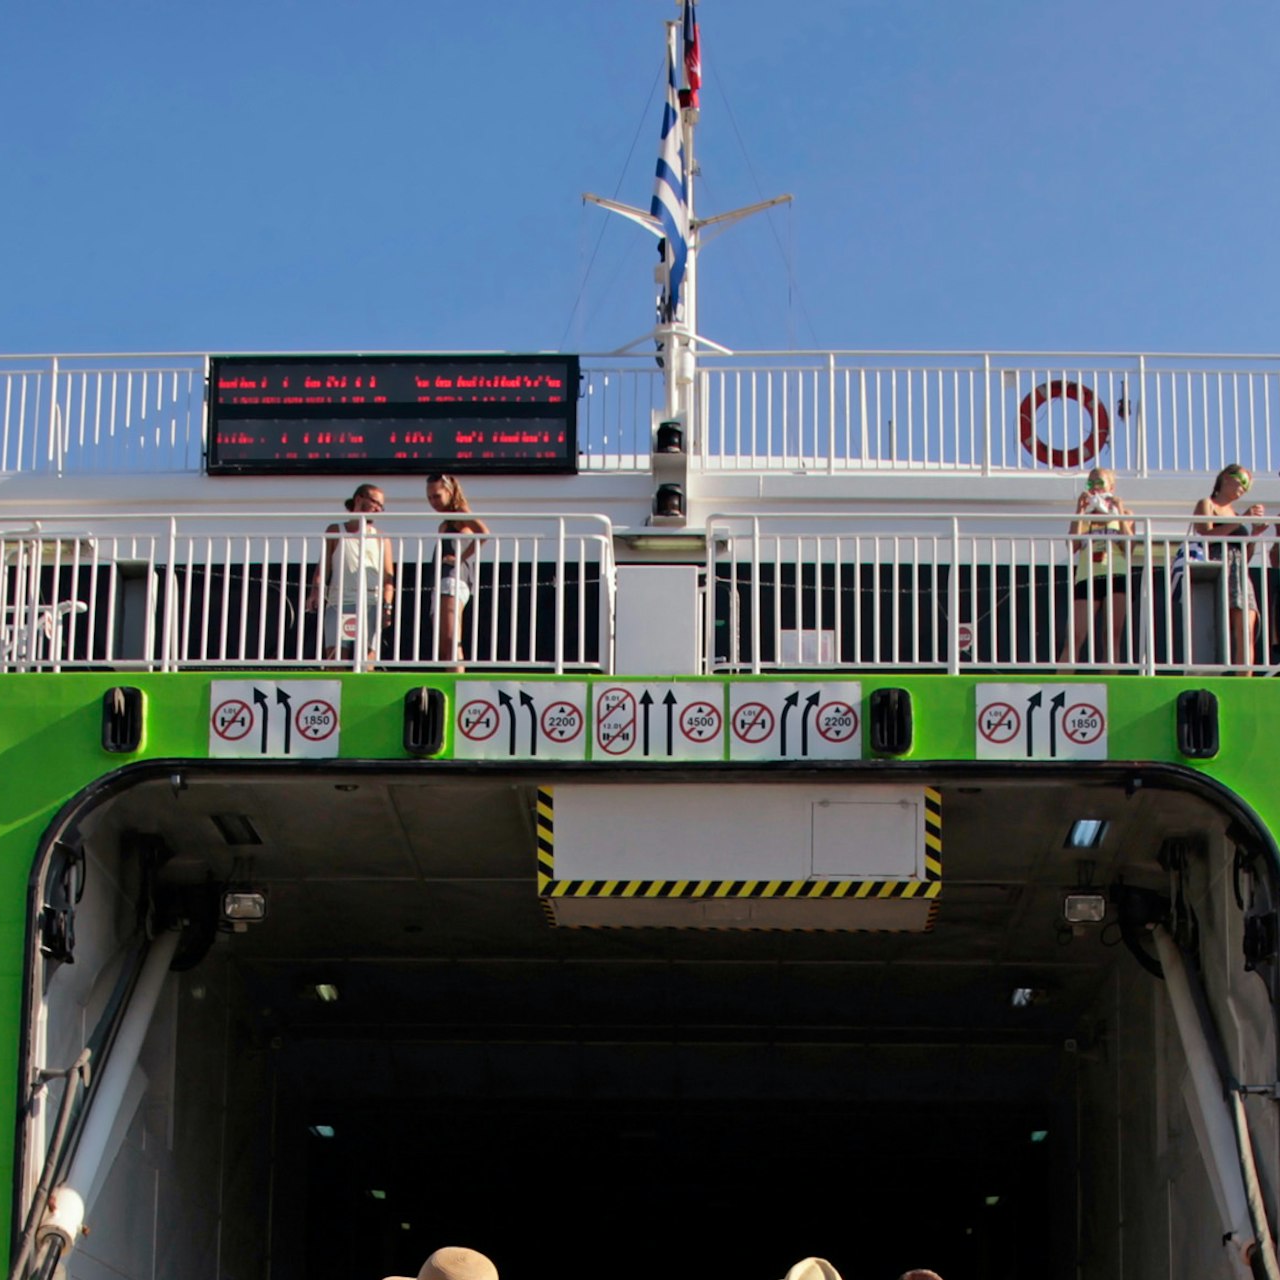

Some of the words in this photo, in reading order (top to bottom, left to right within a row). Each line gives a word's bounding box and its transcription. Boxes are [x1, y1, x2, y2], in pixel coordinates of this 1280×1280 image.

[303, 715, 330, 725] 1850
[548, 717, 576, 727] 2200
[687, 717, 714, 727] 4500
[824, 717, 852, 727] 2200
[1071, 719, 1098, 729] 1850
